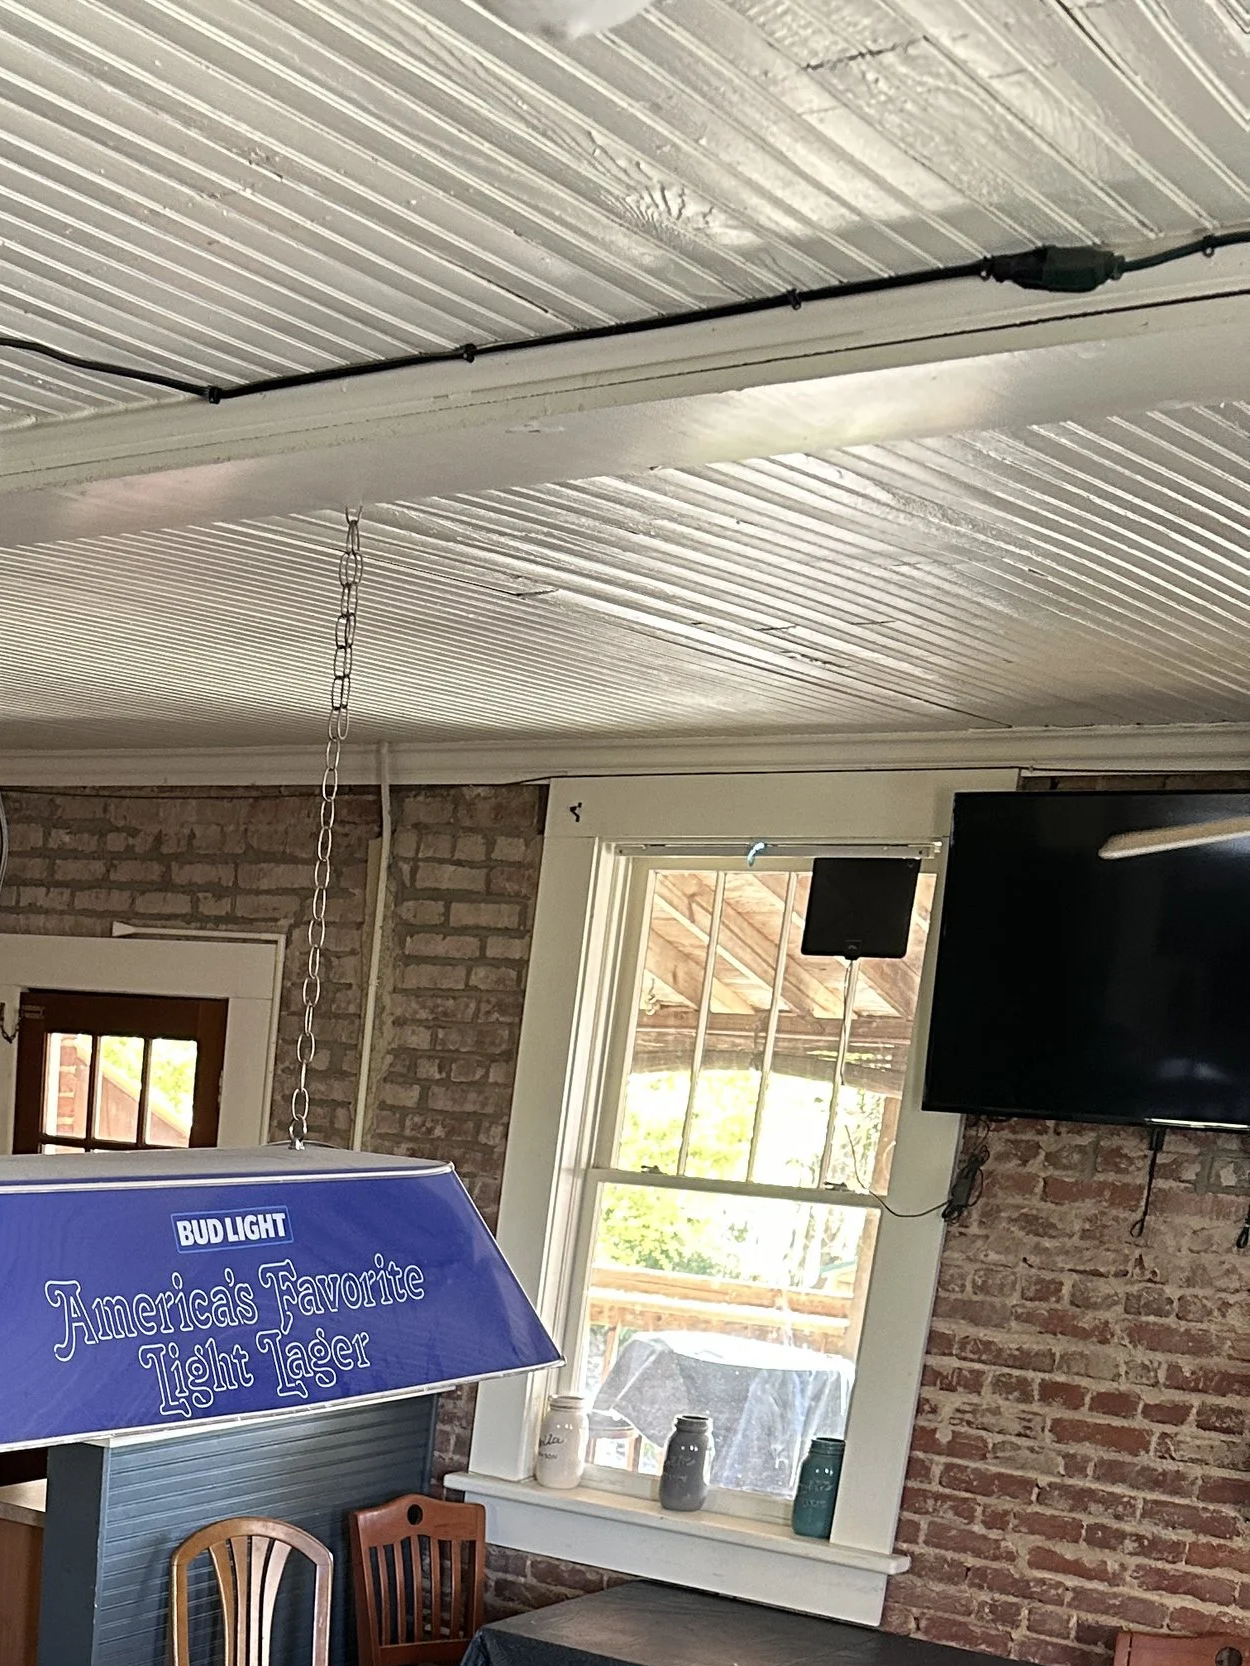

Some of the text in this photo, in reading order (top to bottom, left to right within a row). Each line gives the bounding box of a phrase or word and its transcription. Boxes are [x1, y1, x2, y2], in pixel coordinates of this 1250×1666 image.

[176, 1212, 287, 1247] BUD LIGHT
[45, 1253, 425, 1361] America's Favorite
[139, 1327, 370, 1418] Light Lager
